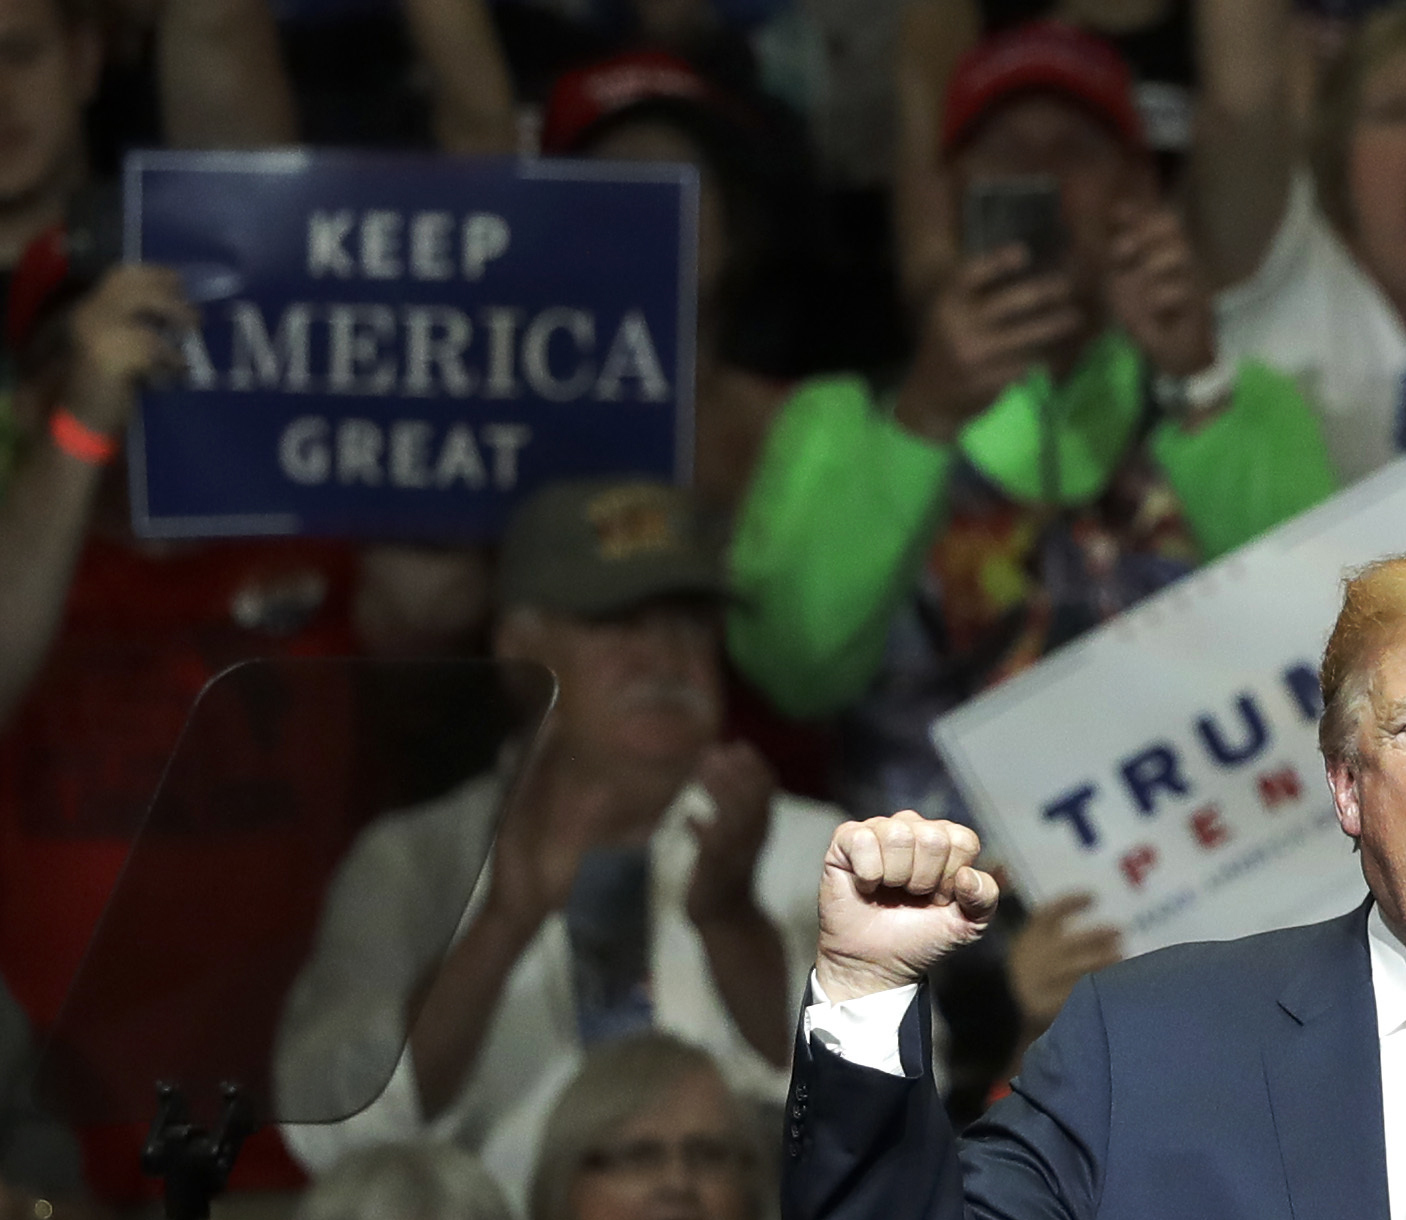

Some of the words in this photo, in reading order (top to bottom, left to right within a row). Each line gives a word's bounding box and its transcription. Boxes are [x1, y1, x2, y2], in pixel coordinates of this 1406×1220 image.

[307, 208, 513, 282] KEEP
[278, 415, 534, 491] GREAT
[1042, 658, 1326, 854] TRU
[1120, 765, 1304, 892] PEN
